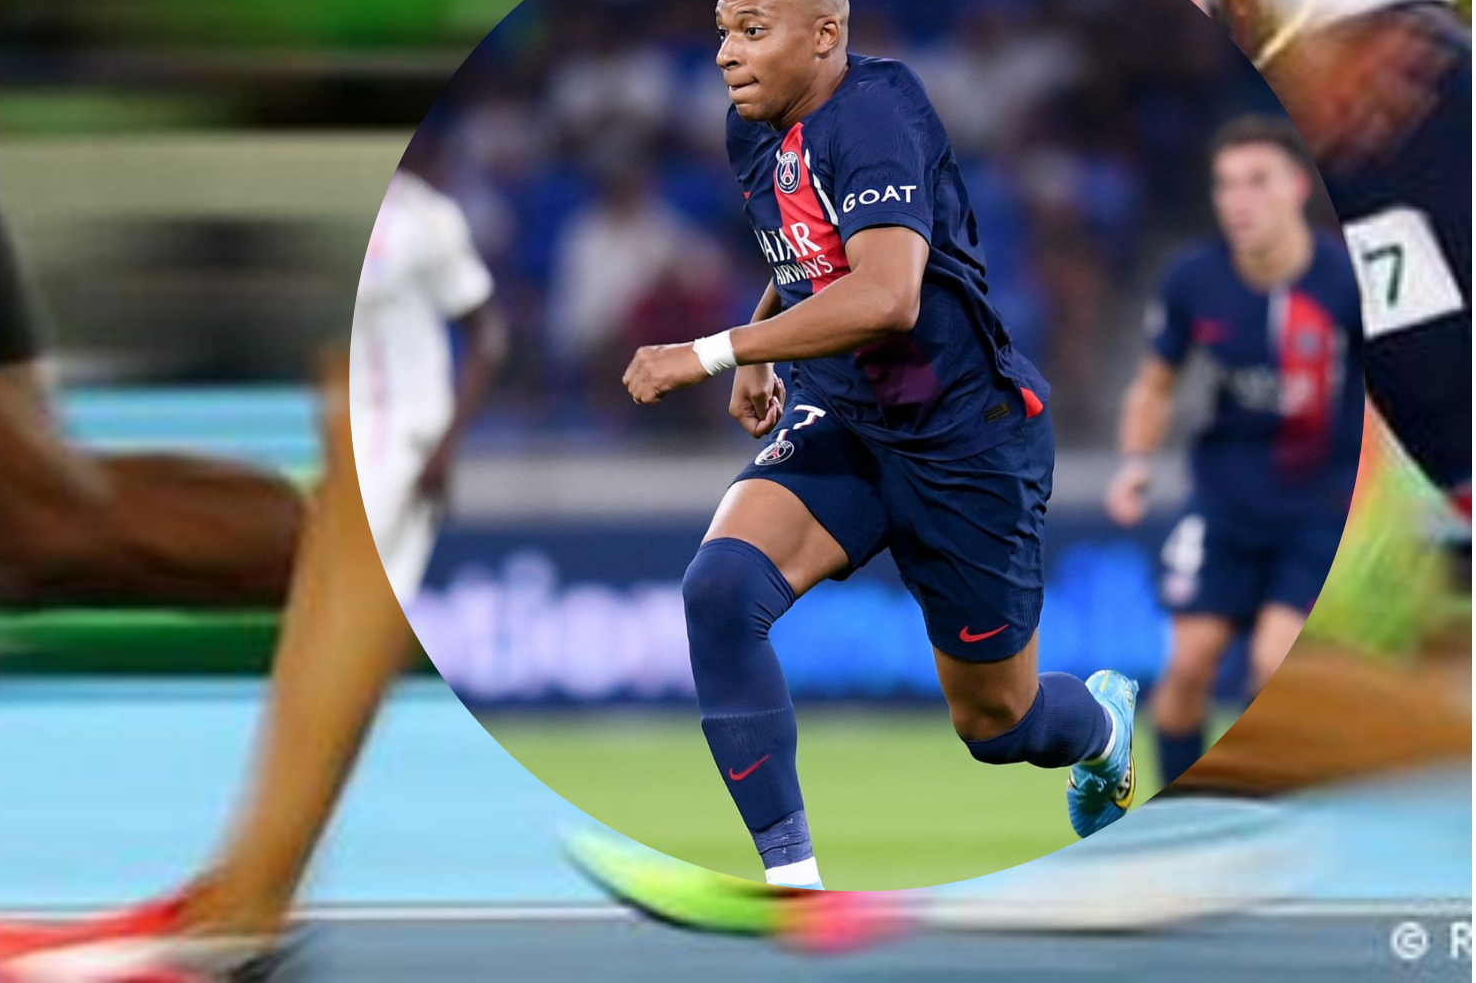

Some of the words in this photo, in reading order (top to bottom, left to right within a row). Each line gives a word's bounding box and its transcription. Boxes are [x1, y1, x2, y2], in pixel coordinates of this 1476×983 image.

[842, 184, 918, 213] GOAT
[772, 253, 834, 286] AIRWAYS
[1362, 243, 1404, 308] 7
[1160, 513, 1208, 576] 4
